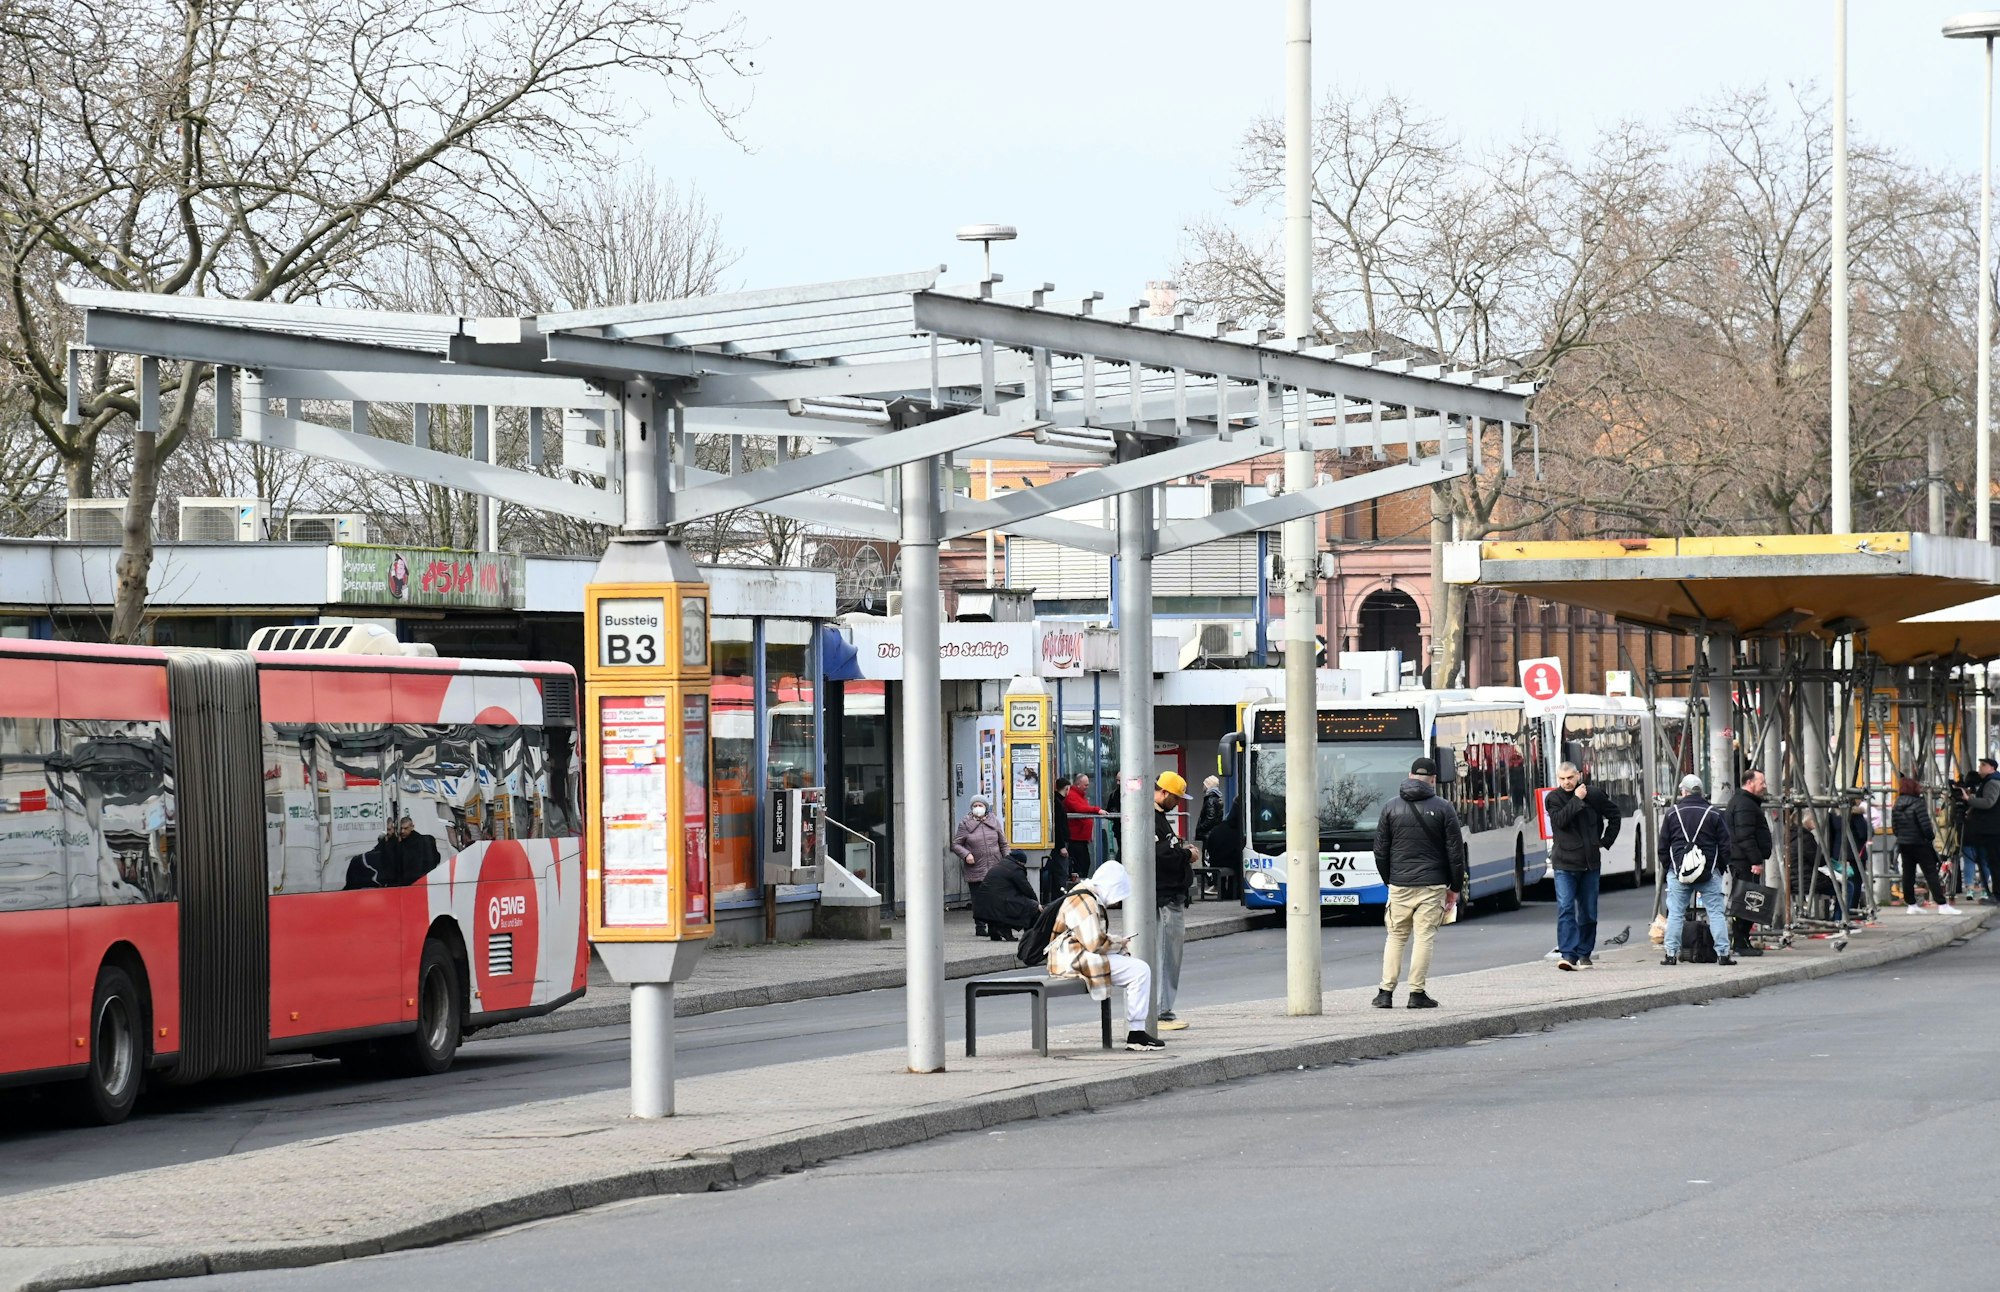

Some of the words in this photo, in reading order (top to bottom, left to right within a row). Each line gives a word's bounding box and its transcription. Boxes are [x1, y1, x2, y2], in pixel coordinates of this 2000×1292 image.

[421, 560, 473, 593] ASIA
[605, 615, 658, 628] Bussteig
[608, 634, 656, 664] B3
[878, 643, 900, 658] Die
[961, 641, 1008, 659] Schärfe
[1013, 713, 1037, 727] C2
[776, 799, 784, 845] zigaretten
[501, 896, 525, 915] SWB
